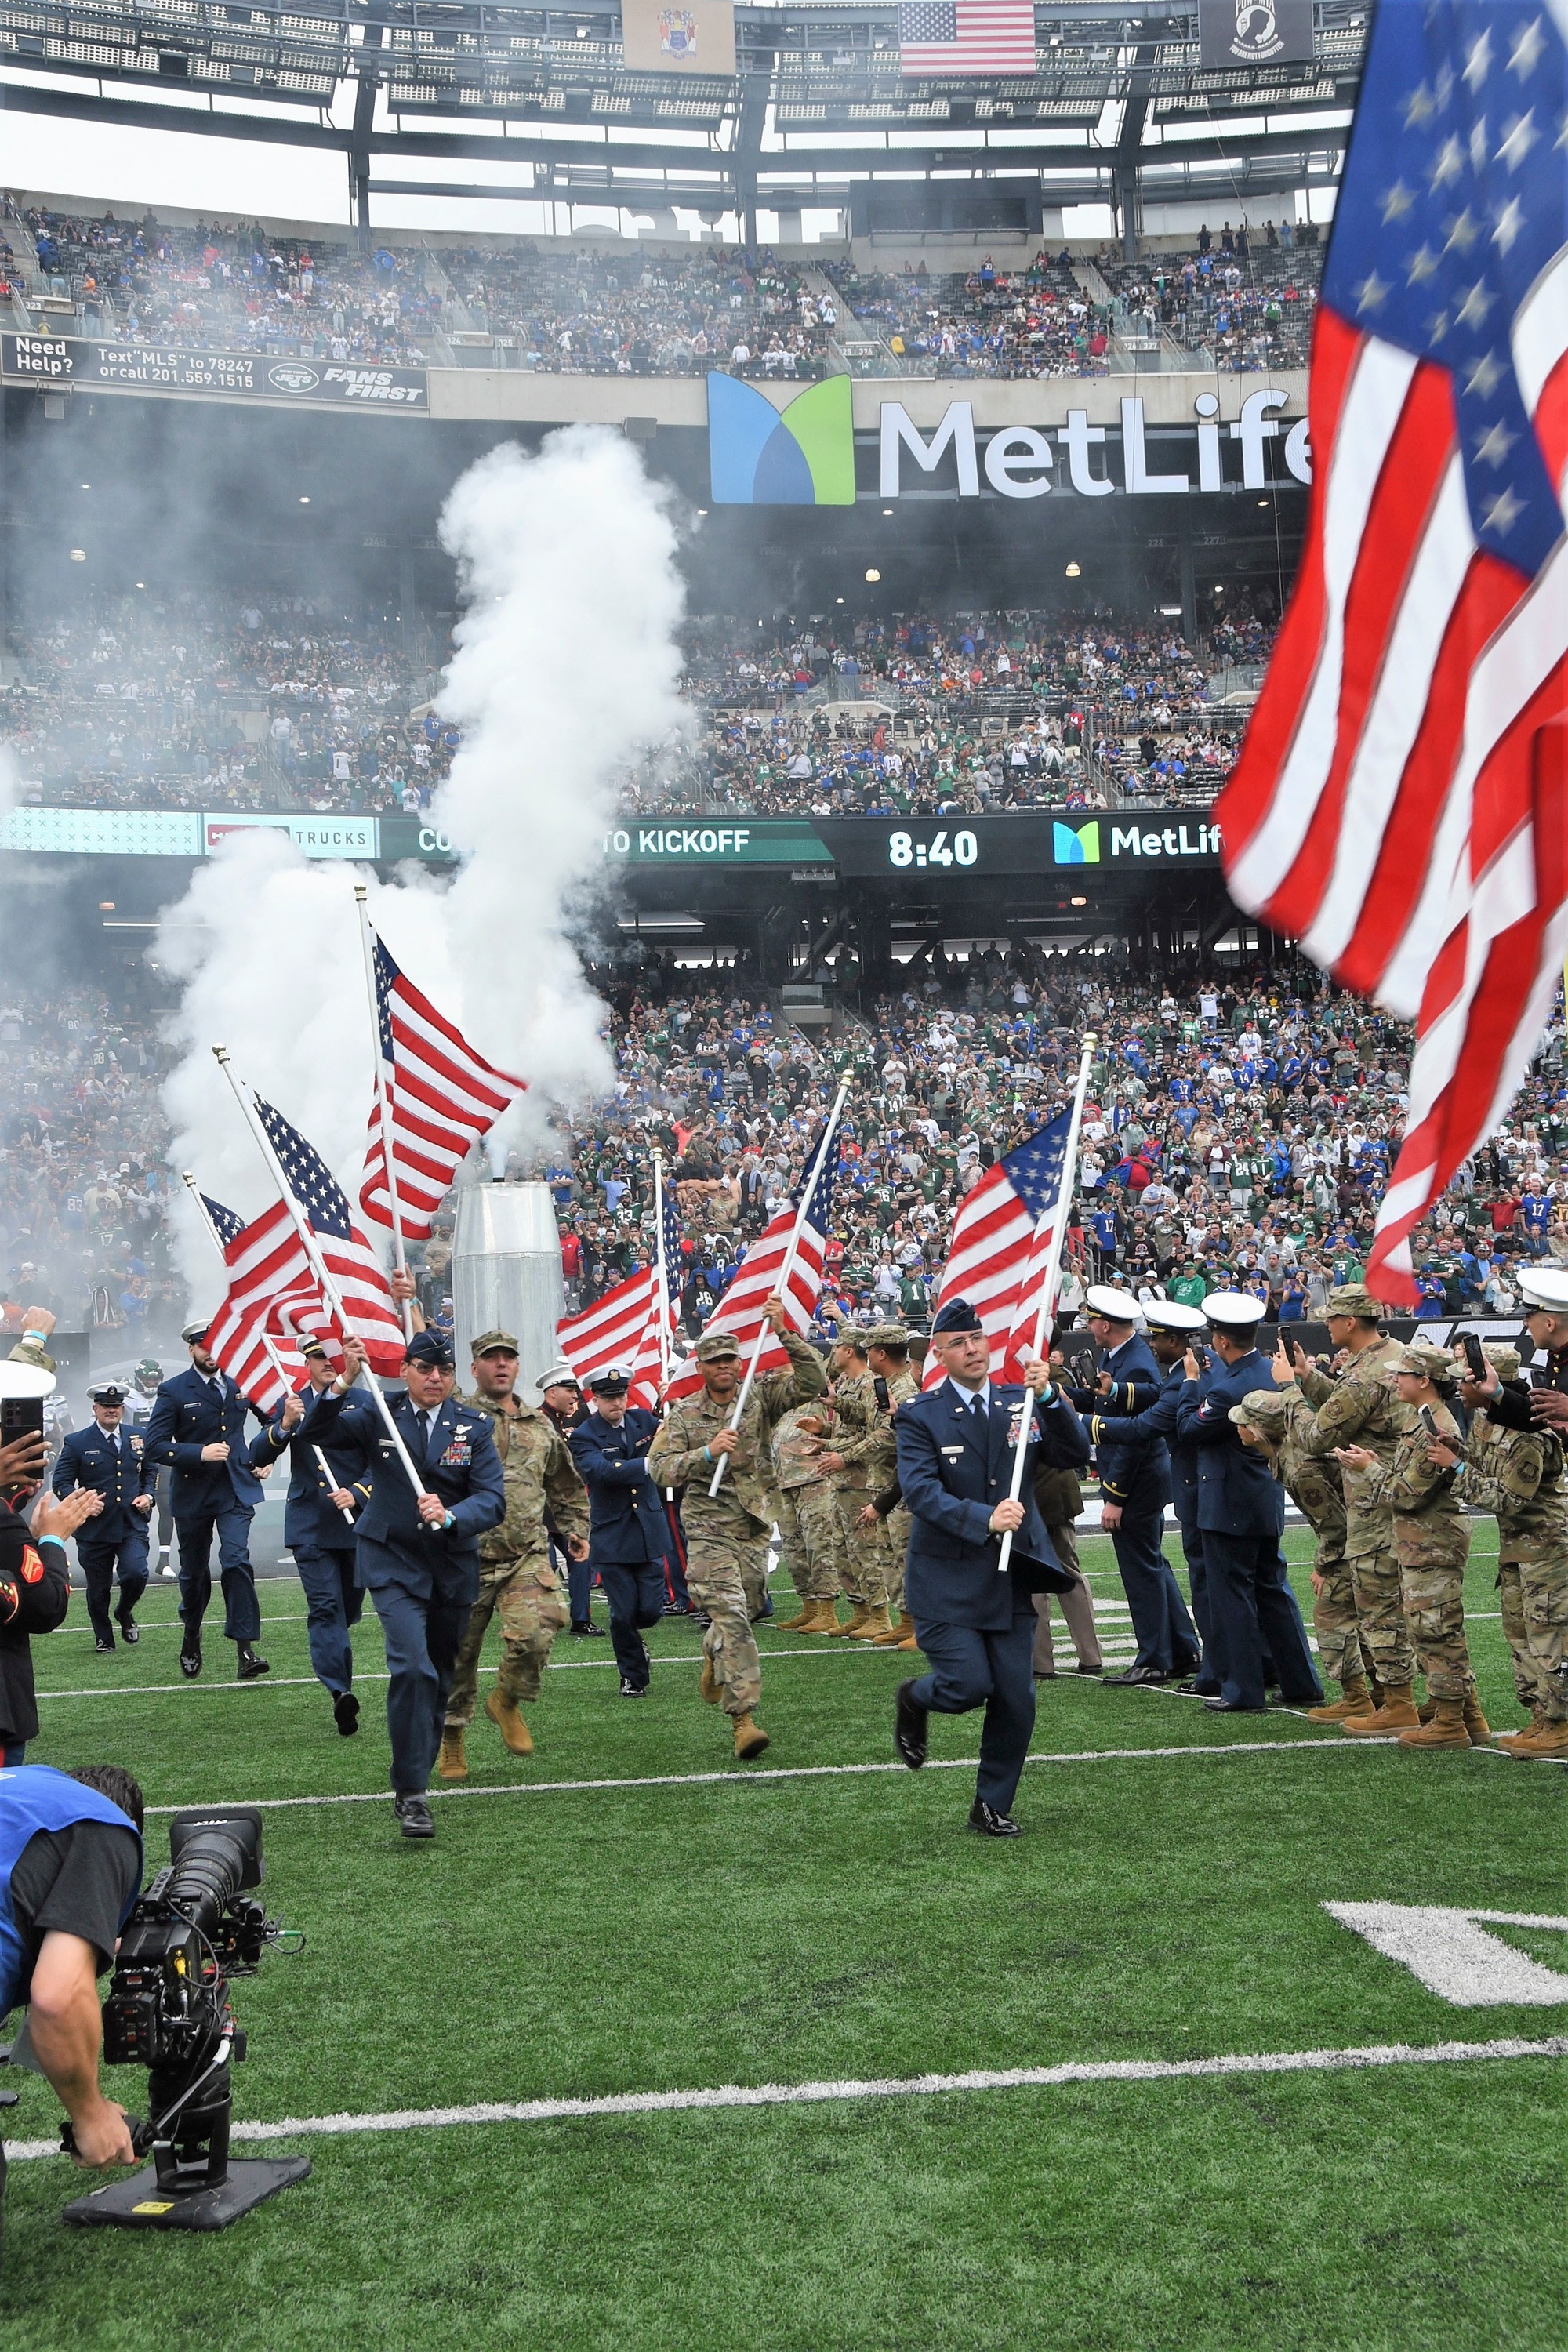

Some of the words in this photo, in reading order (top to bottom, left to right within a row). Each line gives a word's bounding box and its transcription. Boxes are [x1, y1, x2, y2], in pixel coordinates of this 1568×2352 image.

[25, 299, 42, 310] 323
[16, 337, 66, 355] Need
[446, 336, 462, 345] 324
[1144, 341, 1158, 350] 327
[858, 346, 873, 355] 326
[17, 355, 73, 376] Help?
[98, 349, 133, 365] Text
[190, 357, 204, 369] to
[208, 358, 253, 373] 78247
[100, 367, 116, 377] or
[119, 368, 147, 379] call
[152, 369, 254, 388] 201.559.1515
[275, 374, 312, 383] JETS
[323, 368, 393, 385] FANS
[345, 384, 423, 401] FIRST
[805, 634, 814, 644] 80
[432, 721, 439, 730] 17
[941, 733, 946, 742] 2
[162, 740, 172, 749] 12
[837, 769, 842, 778] 2
[296, 831, 366, 844] TRUCKS
[639, 830, 750, 852] KICKOFF
[889, 831, 978, 866] 8:40
[1555, 992, 1564, 1000] 17
[1389, 1021, 1395, 1029] 2
[93, 1053, 104, 1065] 28
[834, 1052, 842, 1063] 17
[857, 1053, 866, 1062] 12
[1311, 1062, 1321, 1072] 14
[708, 1075, 717, 1086] 14
[1218, 1073, 1226, 1082] 13
[1240, 1074, 1250, 1083] 14
[1179, 1085, 1189, 1094] 17
[890, 1100, 899, 1112] 14
[1251, 1098, 1261, 1109] 12
[1156, 1122, 1167, 1134] 24
[1541, 1120, 1549, 1131] 2
[1236, 1162, 1250, 1176] 24
[1261, 1164, 1265, 1177] 1
[617, 1210, 633, 1221] 33
[1532, 1204, 1544, 1217] 17
[1105, 1220, 1114, 1233] 17
[1184, 1221, 1192, 1234] 8
[911, 1283, 920, 1301] 1
[695, 1290, 713, 1307] 28
